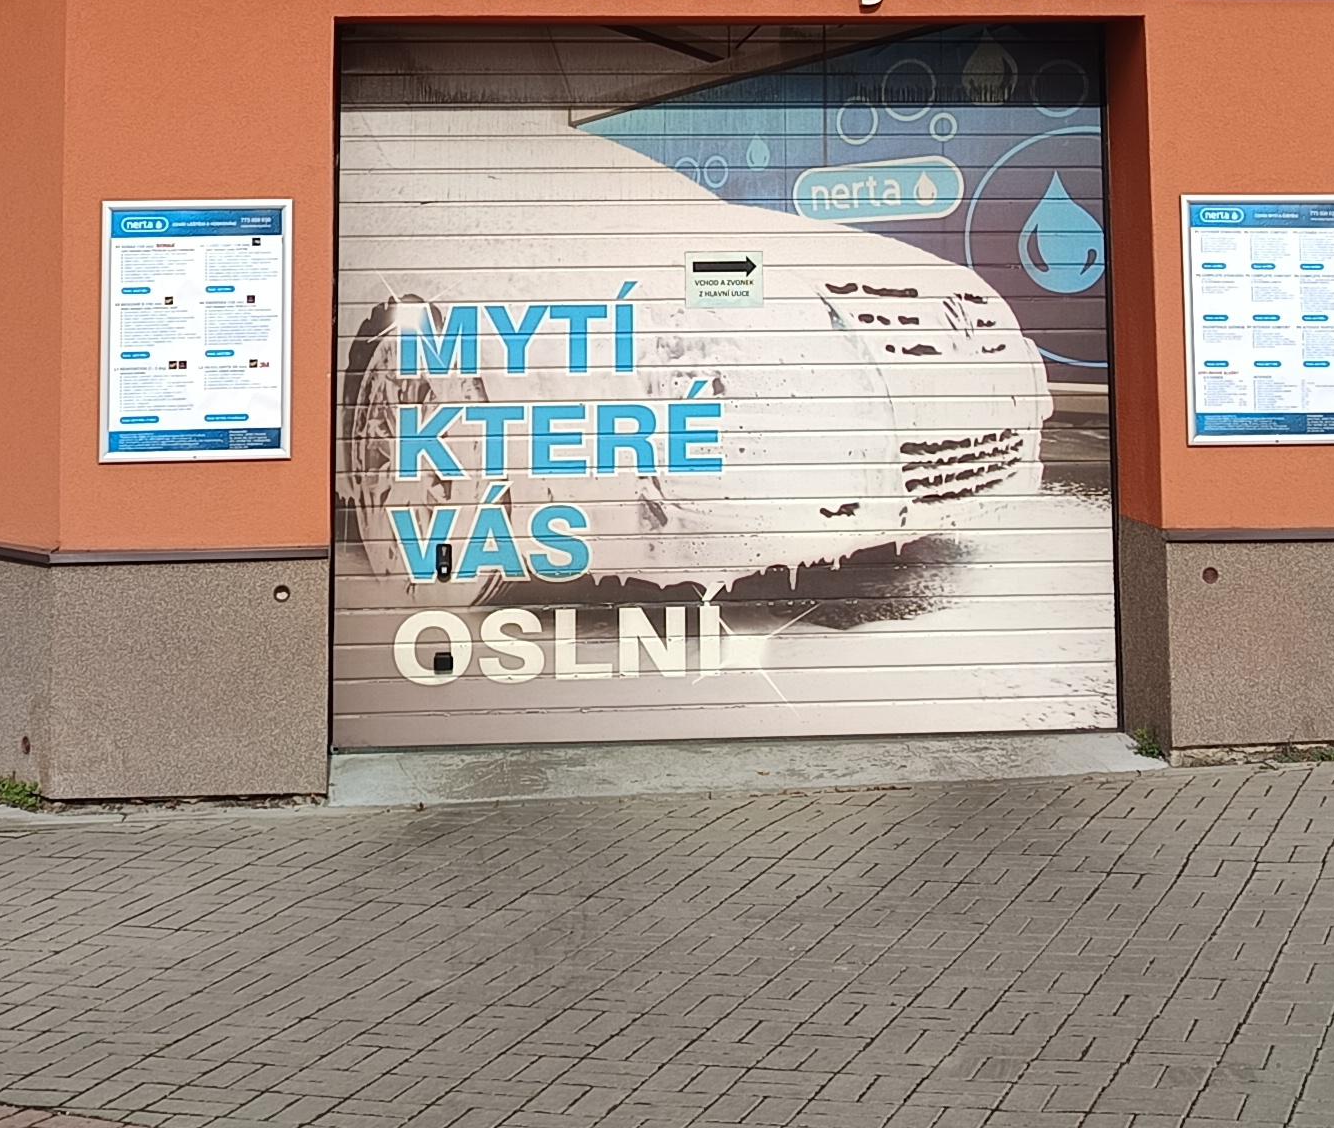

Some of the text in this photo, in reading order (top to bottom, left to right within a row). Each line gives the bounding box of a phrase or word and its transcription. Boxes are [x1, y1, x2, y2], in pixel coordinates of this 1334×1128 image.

[810, 176, 902, 211] nerta
[394, 280, 637, 378] MYTÍ
[394, 381, 725, 482] KTERÉ
[387, 481, 595, 585] VÁS
[393, 584, 722, 686] OSLNÍ
